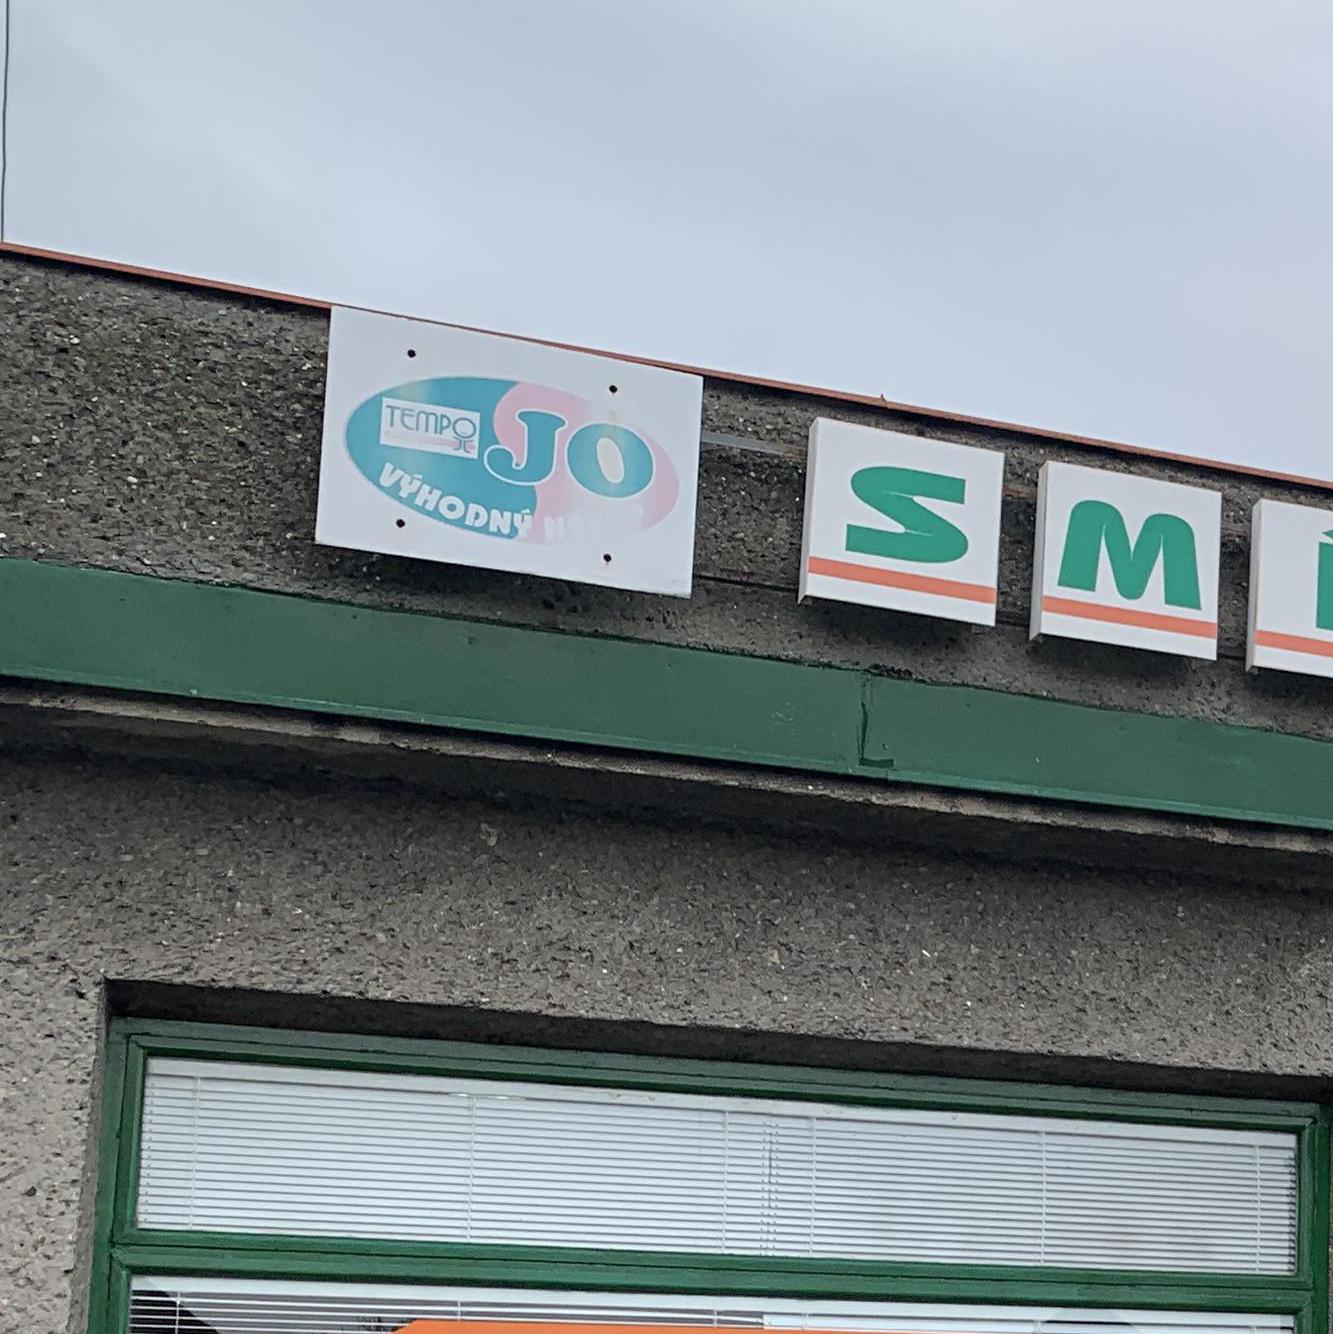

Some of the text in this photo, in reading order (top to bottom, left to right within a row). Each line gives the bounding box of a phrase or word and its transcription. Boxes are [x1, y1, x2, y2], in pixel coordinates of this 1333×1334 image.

[385, 403, 478, 440] TEMPO
[483, 408, 656, 499] JO
[378, 462, 533, 538] VÝHODNÝ
